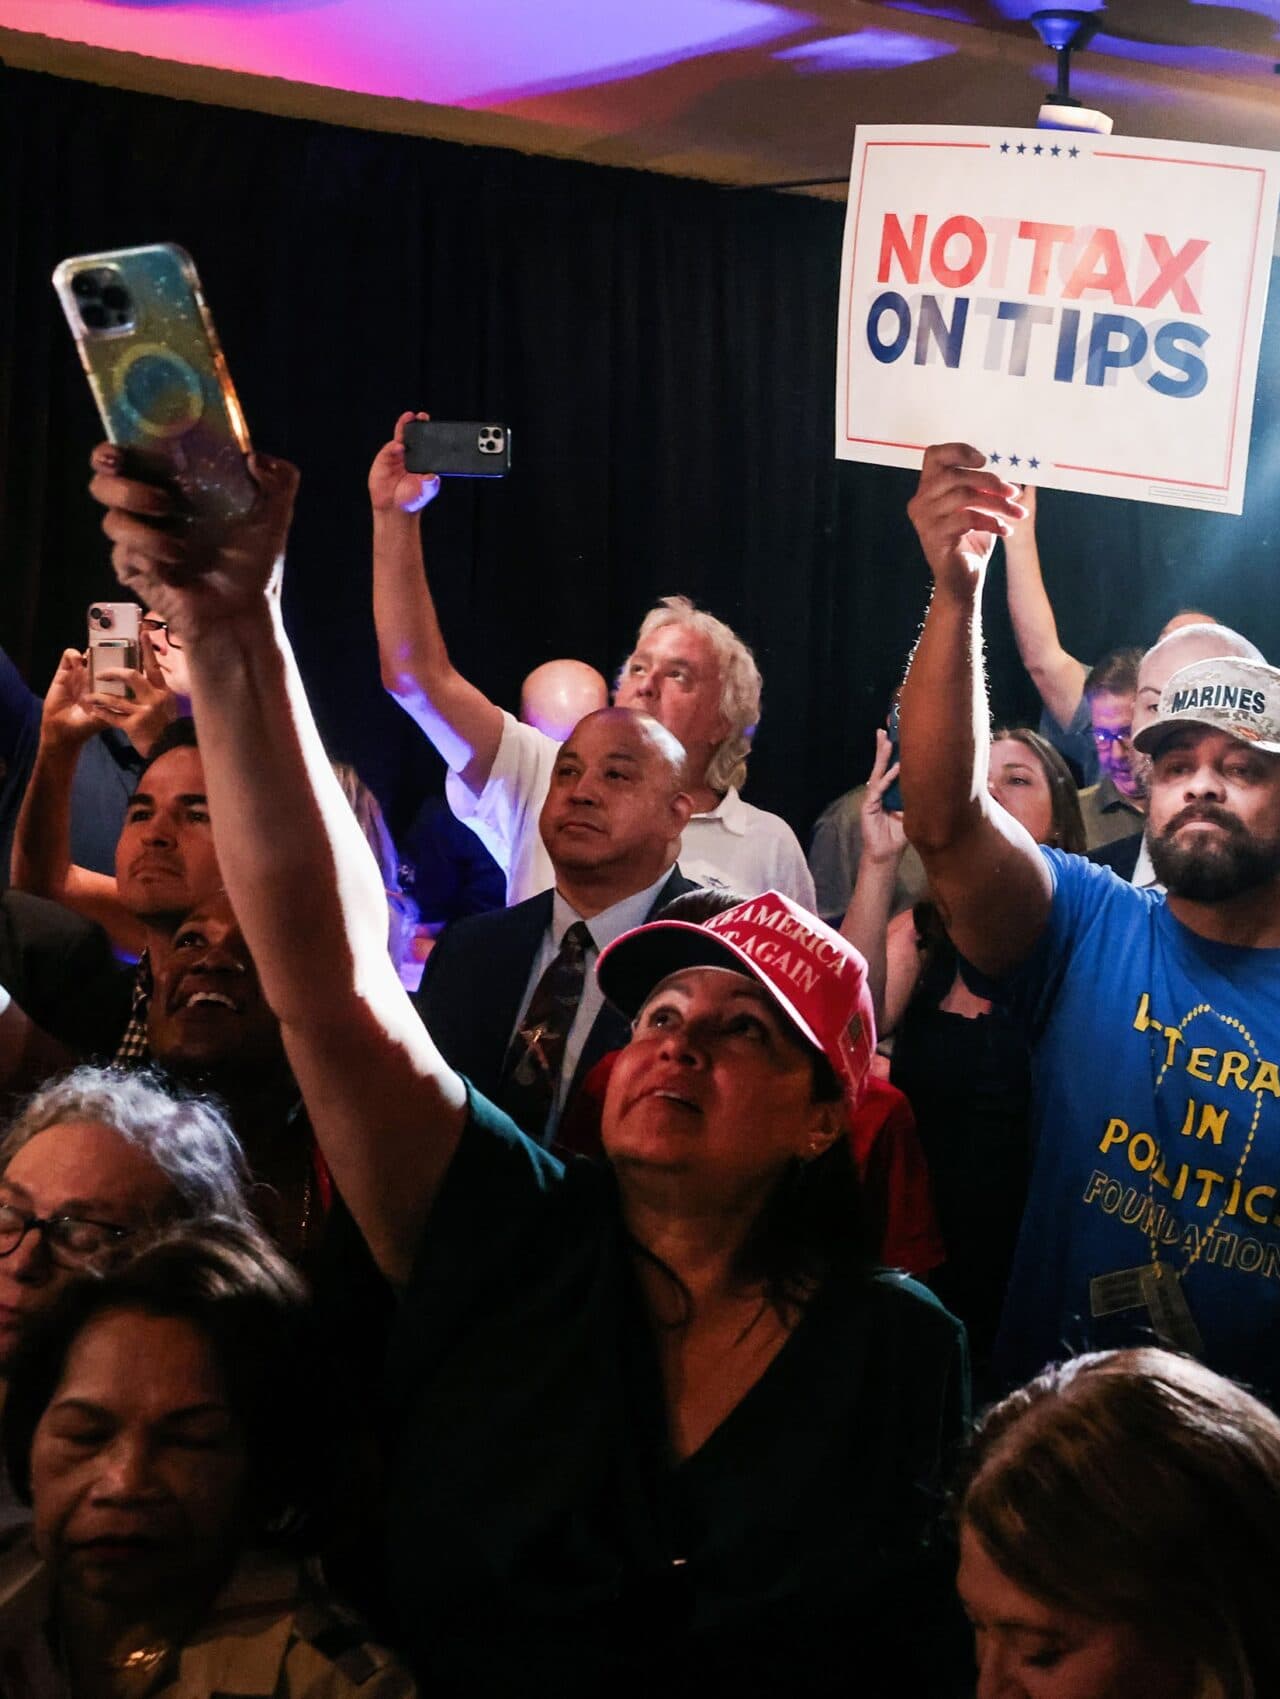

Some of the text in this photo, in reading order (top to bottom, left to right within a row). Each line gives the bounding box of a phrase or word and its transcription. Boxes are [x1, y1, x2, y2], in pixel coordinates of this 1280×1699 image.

[877, 213, 1211, 315] NO TAX
[866, 291, 1211, 399] ON TIPS
[1171, 685, 1266, 714] MARINES
[734, 904, 849, 979] AMERICA
[738, 935, 821, 993] AGAIN
[1181, 1099, 1230, 1145] IN
